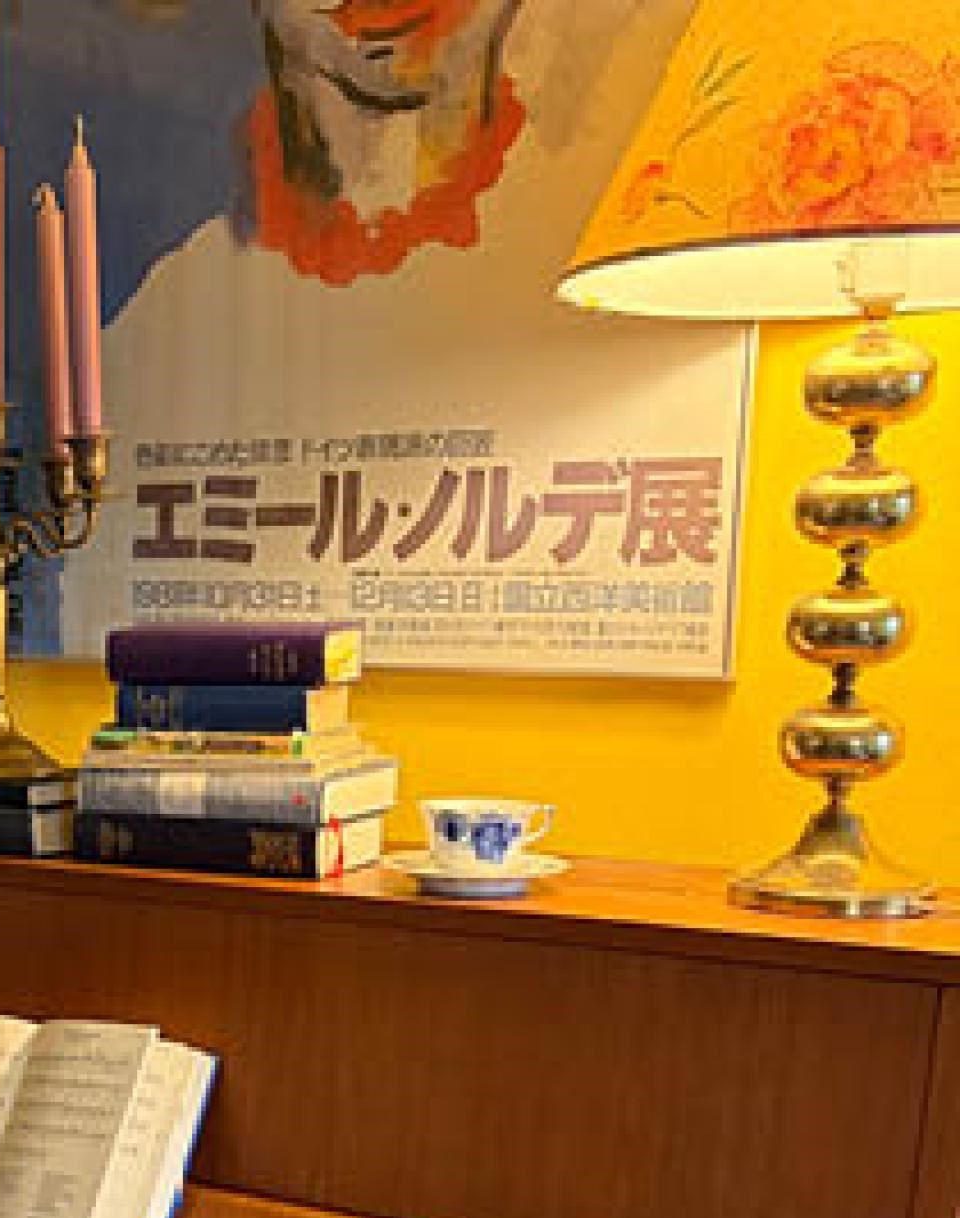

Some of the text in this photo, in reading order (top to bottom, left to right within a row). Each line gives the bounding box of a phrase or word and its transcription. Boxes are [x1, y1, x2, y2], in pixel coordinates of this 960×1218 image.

[132, 456, 724, 564] エミール・ノルデ展
